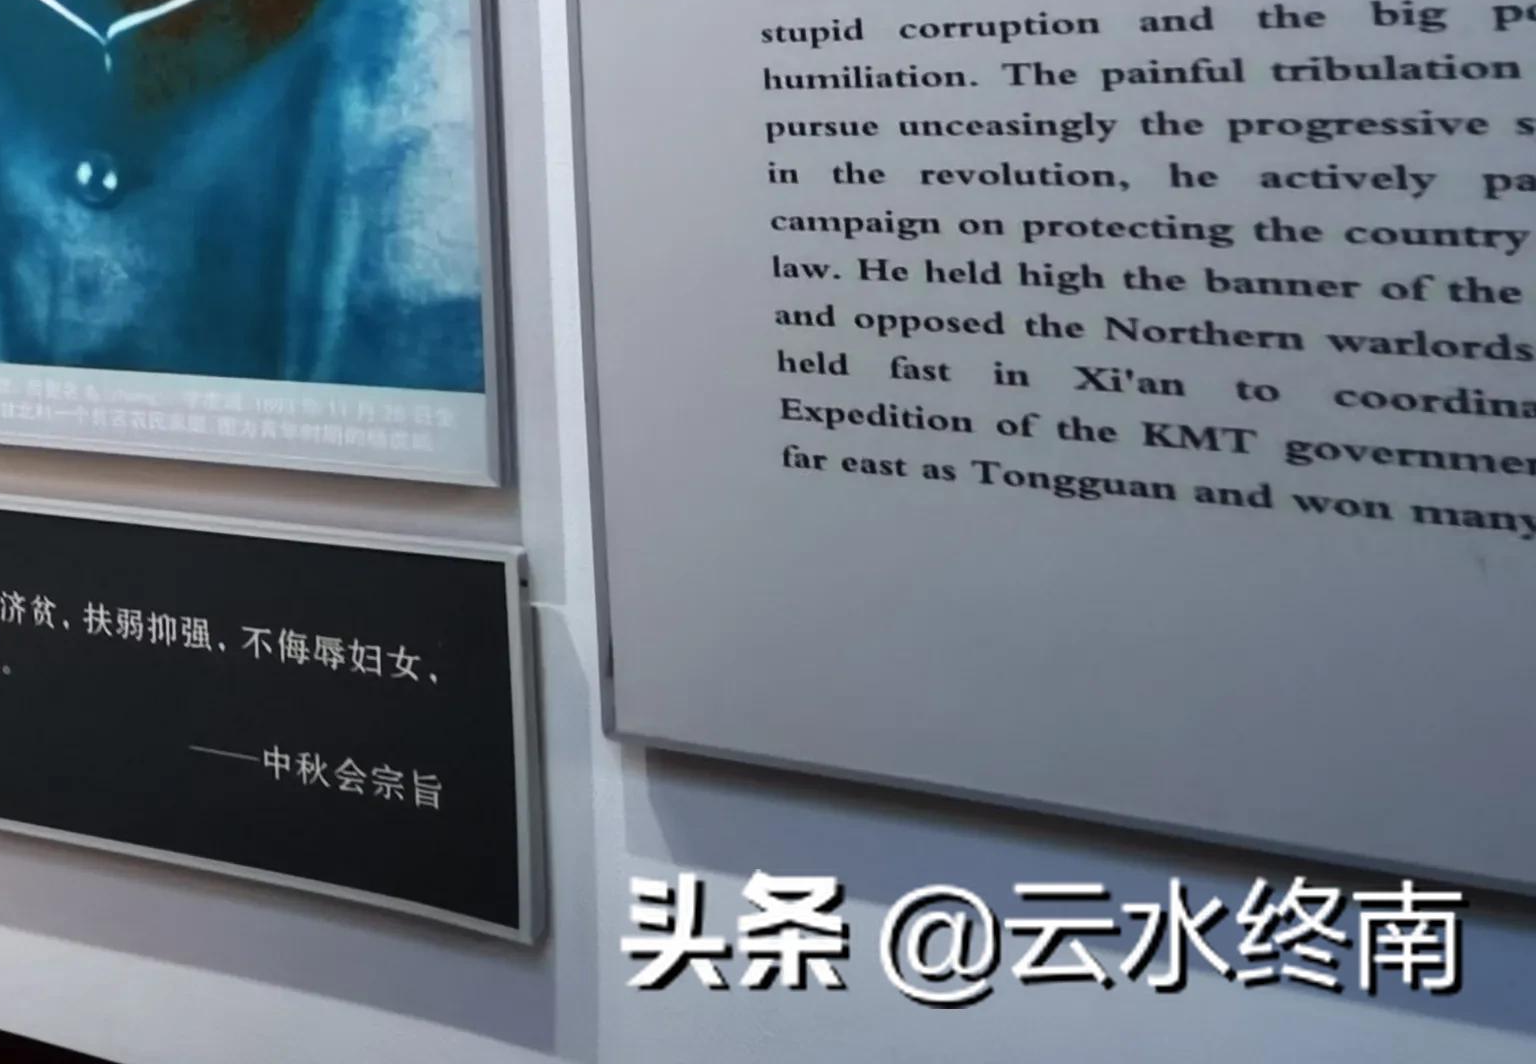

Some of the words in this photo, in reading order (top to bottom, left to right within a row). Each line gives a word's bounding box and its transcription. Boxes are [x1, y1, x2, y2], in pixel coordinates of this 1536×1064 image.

[761, 17, 864, 49] stupid
[899, 11, 1101, 44] corruption
[1139, 5, 1214, 33] and
[1257, 3, 1326, 29] the
[1370, 0, 1448, 33] big
[763, 65, 979, 90] humiliation.
[1001, 62, 1077, 86] The
[1101, 57, 1245, 92] painful
[1270, 54, 1522, 82] tribulation
[765, 121, 879, 144] pursue
[899, 112, 1117, 144] unceasingly
[1140, 110, 1204, 136] the
[1227, 109, 1489, 144] progressive
[768, 161, 799, 184] in
[833, 161, 886, 184] the
[920, 162, 1130, 192] revolution,
[1169, 162, 1219, 188] he
[1260, 164, 1437, 199] actively
[770, 210, 941, 240] campaign
[958, 219, 1004, 235] on
[1022, 214, 1235, 248] protecting
[1253, 216, 1323, 243] the
[1344, 227, 1530, 256] country
[772, 255, 841, 280] law.
[858, 258, 908, 282] He
[925, 259, 1002, 285] held
[1018, 262, 1105, 295] high
[1123, 265, 1186, 291] the
[1204, 267, 1362, 299] banner
[1380, 274, 1435, 301] of
[1448, 276, 1522, 304] the
[775, 304, 836, 327] and
[854, 311, 1005, 338] opposed
[1025, 312, 1084, 339] the
[1105, 316, 1304, 351] Northern
[1325, 330, 1535, 362] warlords
[777, 349, 850, 376] held
[891, 355, 952, 382] fast
[994, 361, 1030, 387] in
[1073, 366, 1186, 397] Xi'an
[1235, 380, 1280, 402] to
[780, 398, 973, 433] Expedition
[996, 412, 1041, 438] of
[1057, 416, 1118, 443] the
[1141, 421, 1257, 454] KMT
[782, 444, 828, 471] far
[841, 457, 907, 477] east
[922, 464, 957, 482] as
[970, 460, 1176, 501] Tongguan
[1194, 483, 1274, 509] and
[1291, 494, 1394, 521] won
[1410, 505, 1536, 540] many
